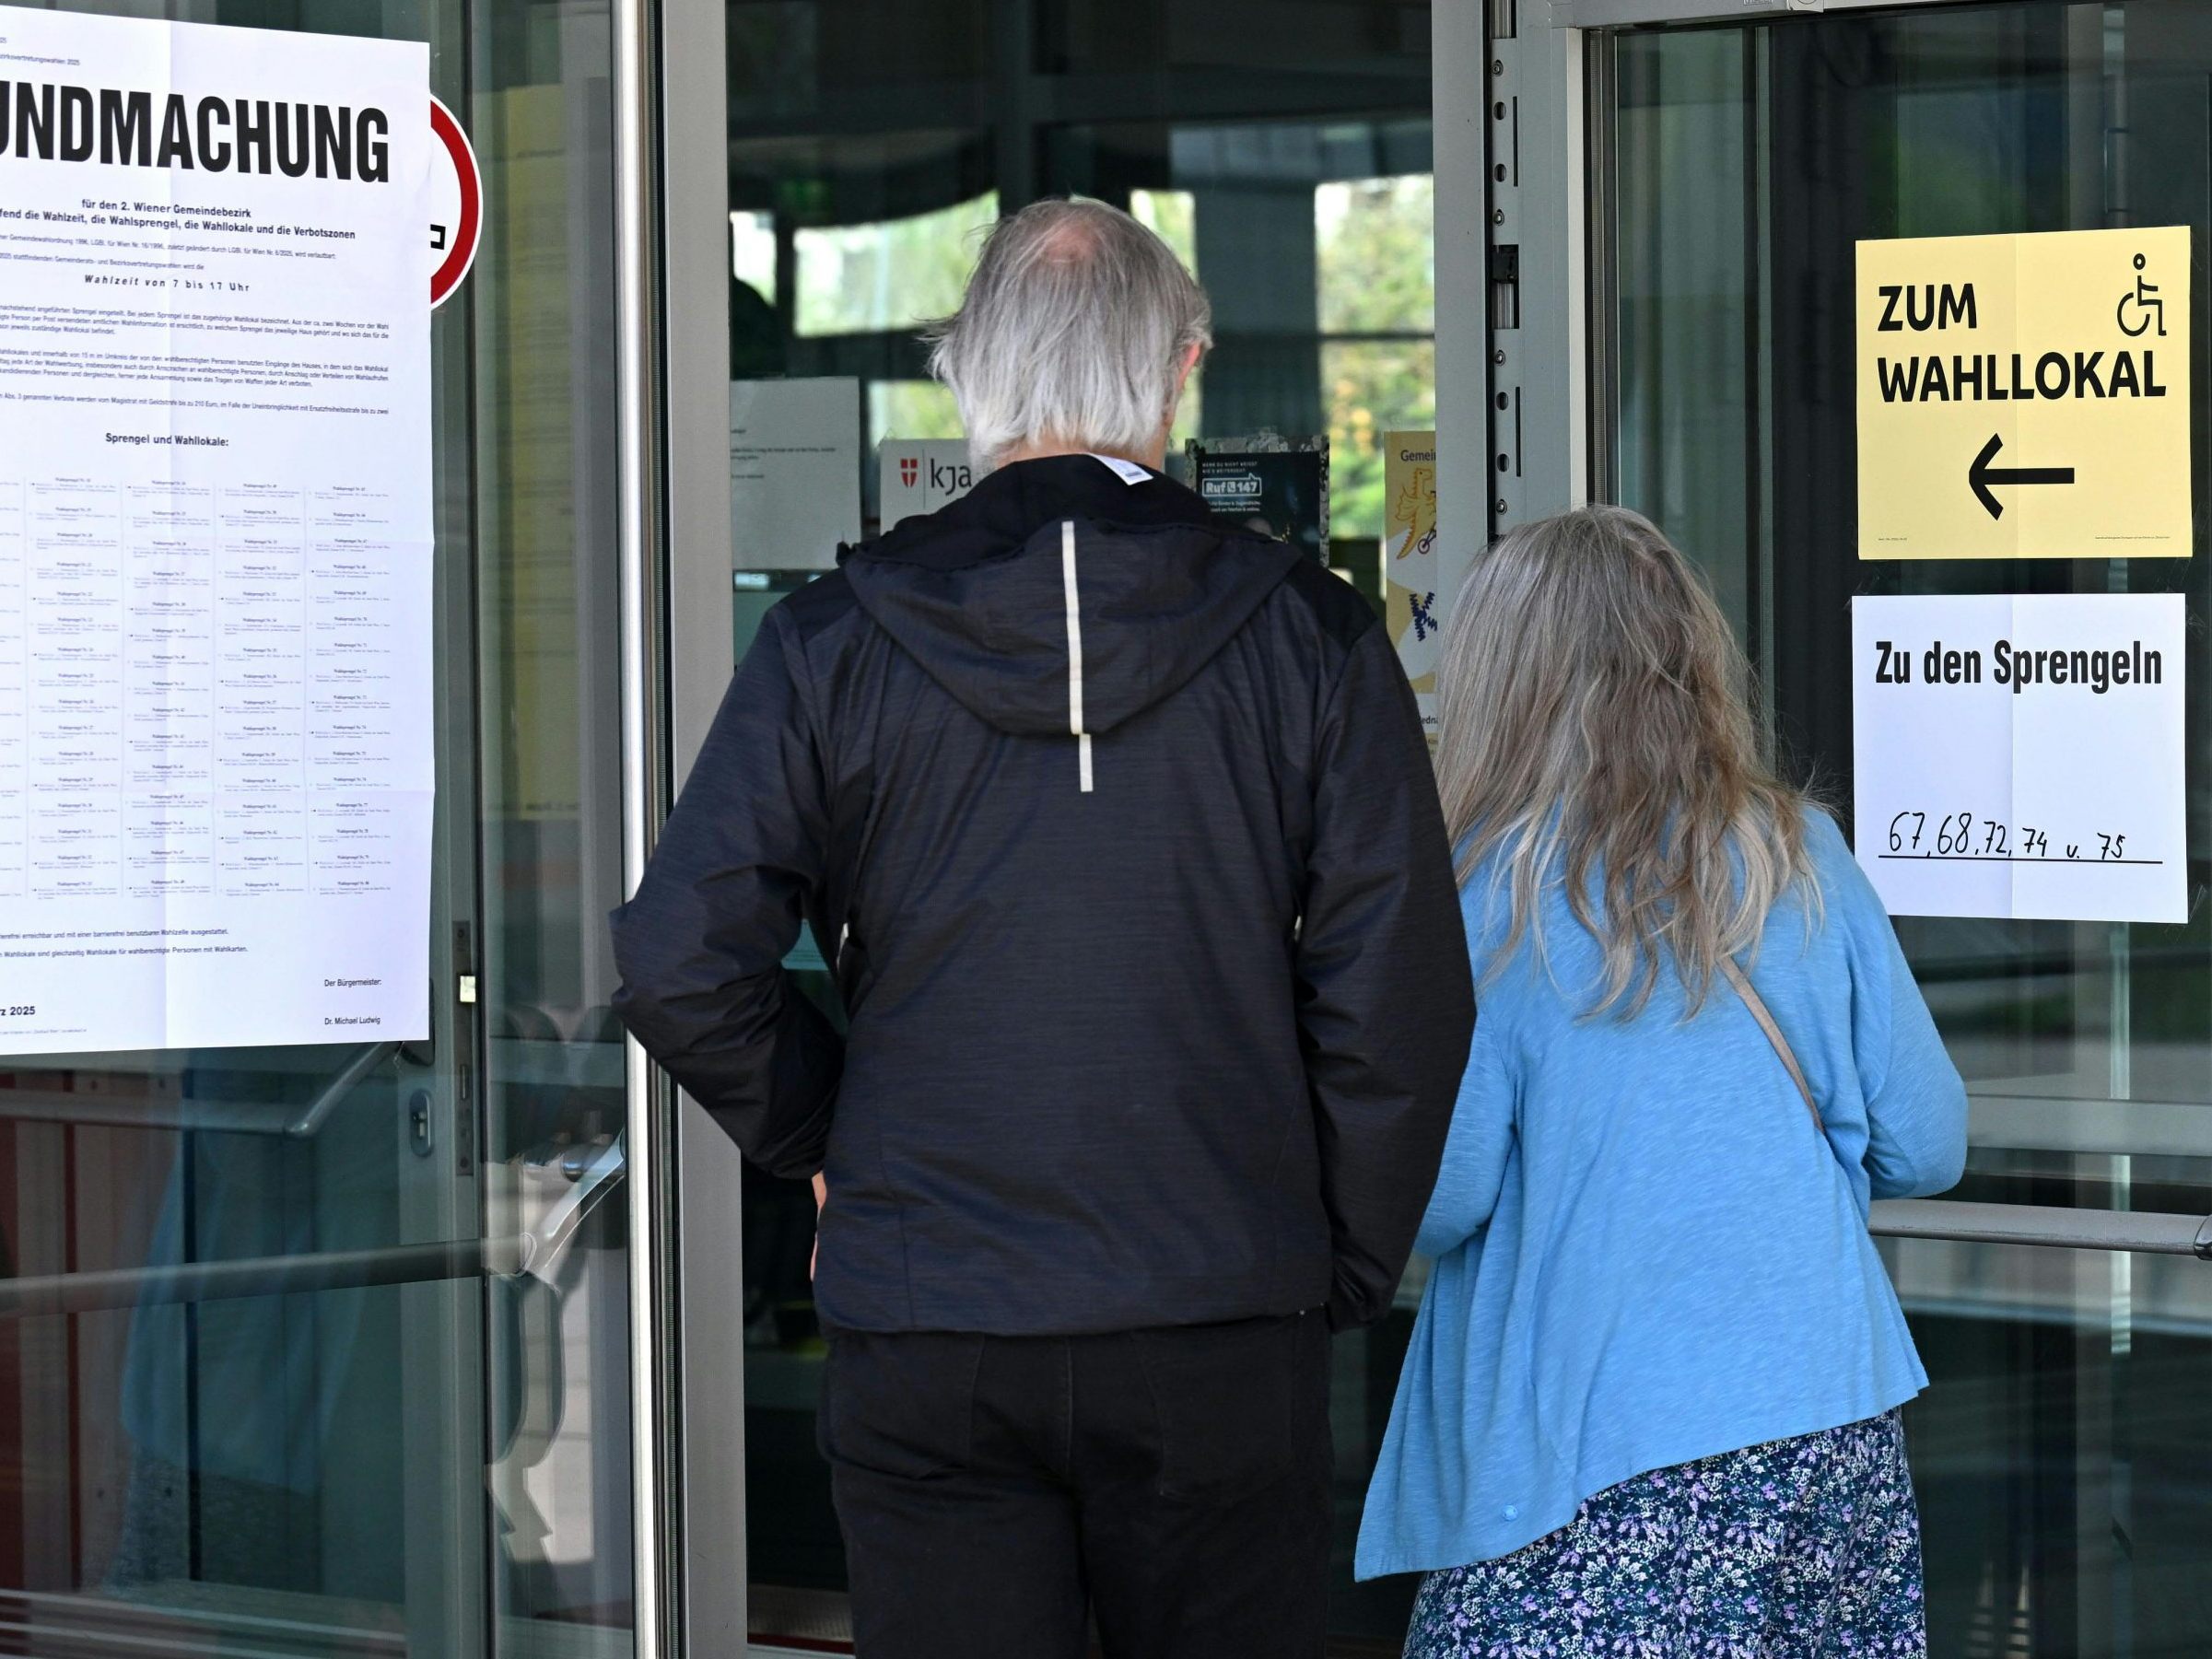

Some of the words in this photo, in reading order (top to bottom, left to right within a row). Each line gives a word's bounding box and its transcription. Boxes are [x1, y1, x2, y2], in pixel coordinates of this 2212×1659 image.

[82, 199, 96, 208] für
[99, 199, 117, 210] den
[121, 201, 130, 210] 2.
[134, 203, 170, 214] Wiener
[173, 204, 251, 217] Gemeindebezirk
[25, 210, 40, 221] die
[42, 210, 88, 225] Wahlzeit,
[91, 214, 106, 225] die
[110, 216, 181, 230] Wahlsprengel,
[184, 219, 199, 230] die
[202, 221, 253, 232] Wahllokale
[256, 225, 274, 234] und
[276, 225, 291, 236] die
[294, 227, 356, 240] Verbotszonen
[85, 275, 138, 286] Wahlzeit
[185, 280, 203, 289] bis
[229, 282, 250, 291] Uhr
[1878, 283, 1977, 332] ZUM
[1878, 350, 2166, 403] WAHLLOKAL
[106, 433, 150, 446] Sprengel
[154, 435, 172, 444] und
[174, 435, 229, 446] Wahllokale:
[930, 458, 972, 496] kja
[1206, 482, 1226, 493] Ruf
[1236, 481, 1258, 493] 147
[1875, 641, 1911, 683] Zu
[1924, 641, 1982, 683] den
[1994, 640, 2162, 694] Sprengeln
[2097, 832, 2125, 860] 75
[9, 1006, 36, 1015] 2025
[359, 1016, 381, 1024] Ludwig
